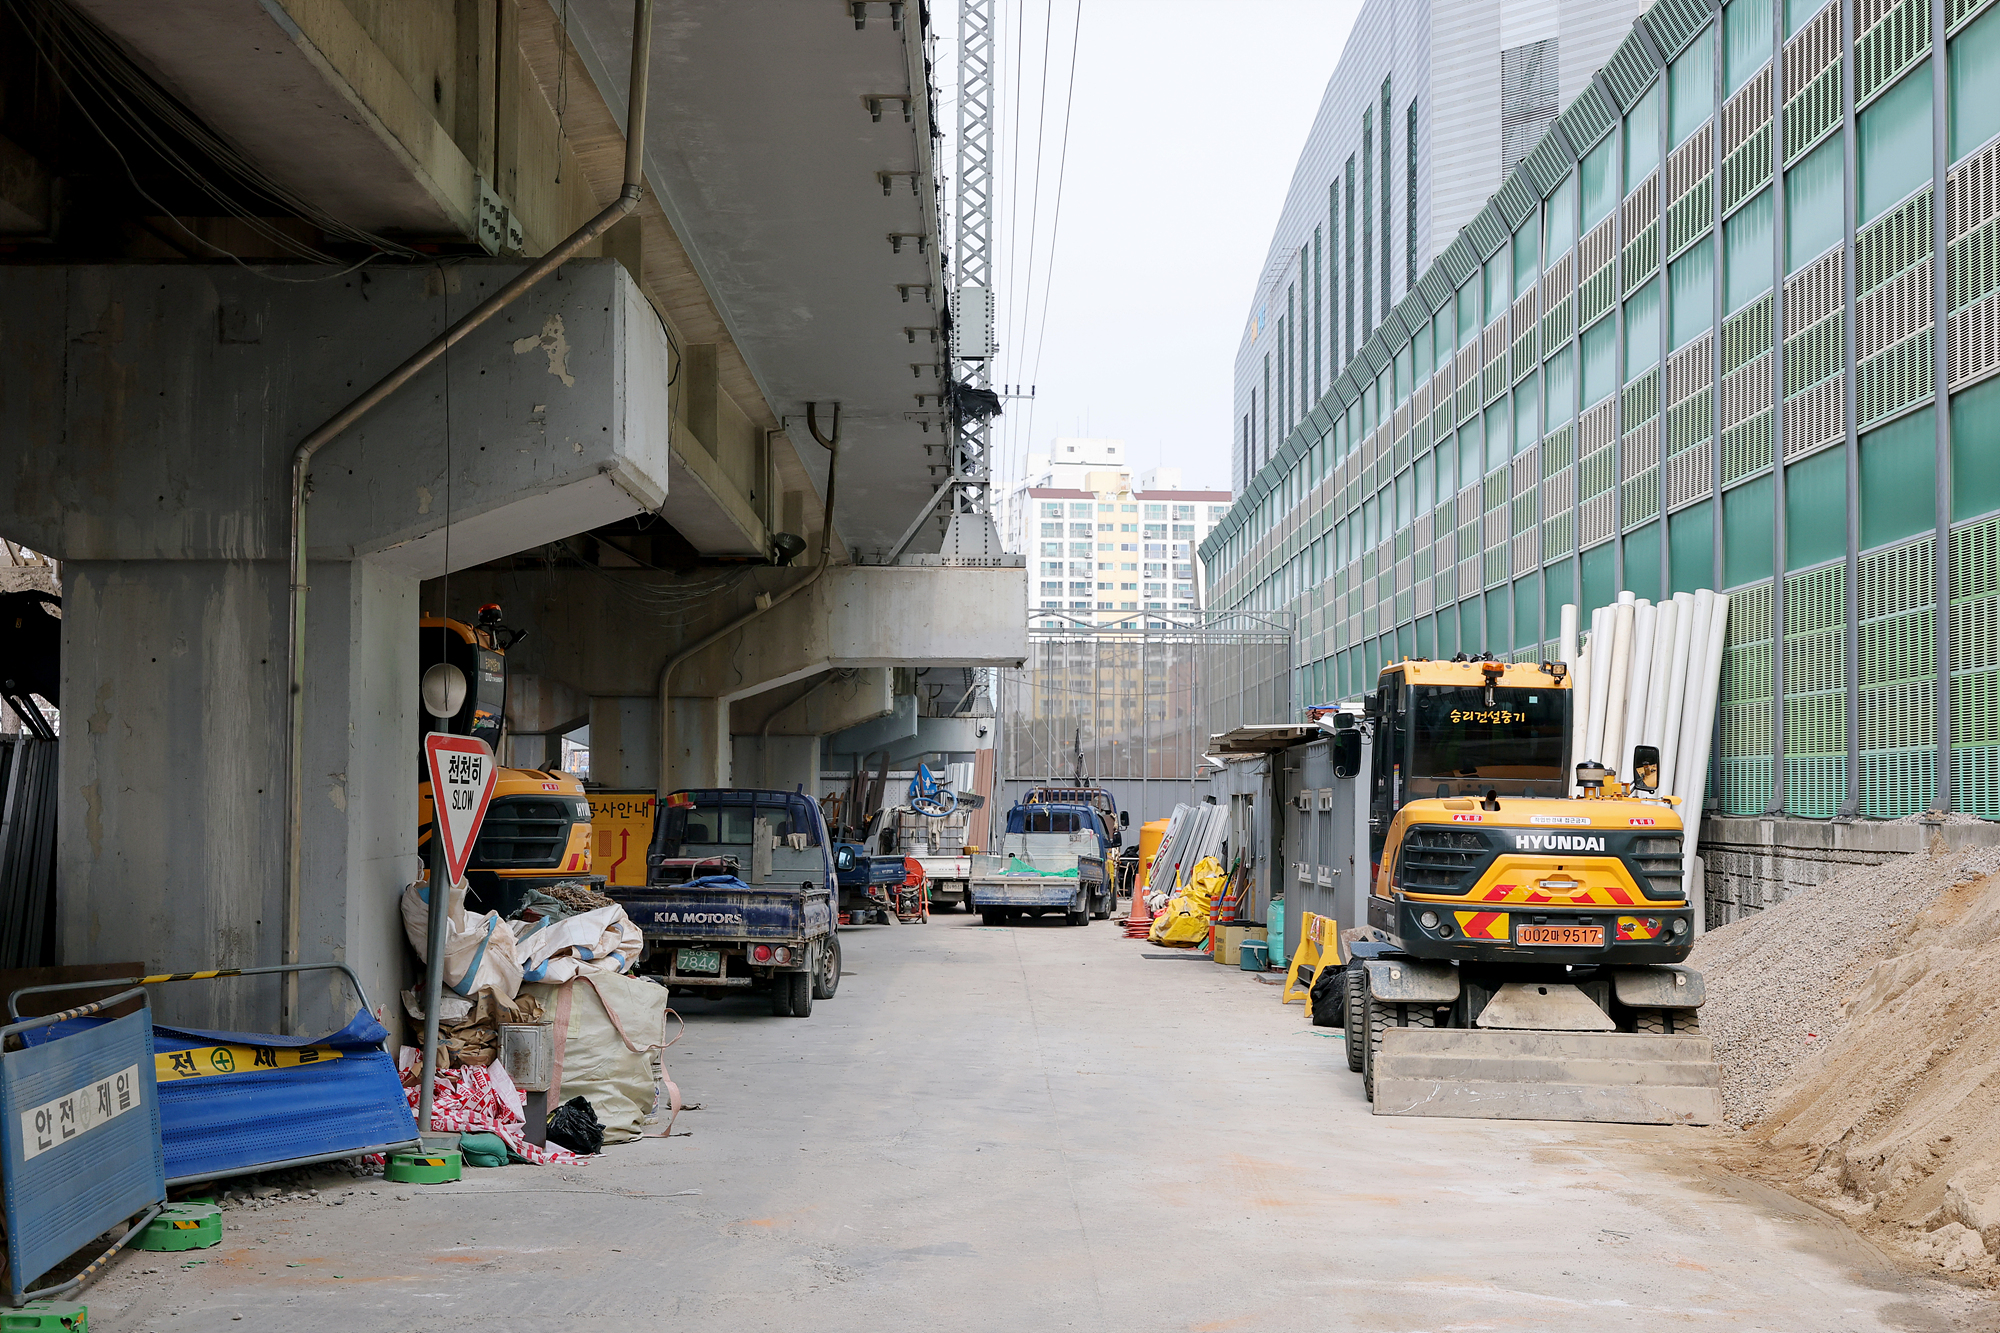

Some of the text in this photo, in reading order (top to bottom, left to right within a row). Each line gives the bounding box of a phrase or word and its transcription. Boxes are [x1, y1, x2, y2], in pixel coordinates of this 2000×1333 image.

[1450, 709, 1526, 725] 승리건설중기
[448, 754, 482, 786] 천천히
[452, 789, 475, 811] SLOW
[1516, 835, 1606, 852] HYUNDAI
[654, 912, 743, 925] KIA MOTORS
[1523, 928, 1598, 943] 002마 9517
[680, 956, 717, 971] 7846
[169, 1050, 202, 1078] 전
[35, 1072, 131, 1151] 안전 제일
